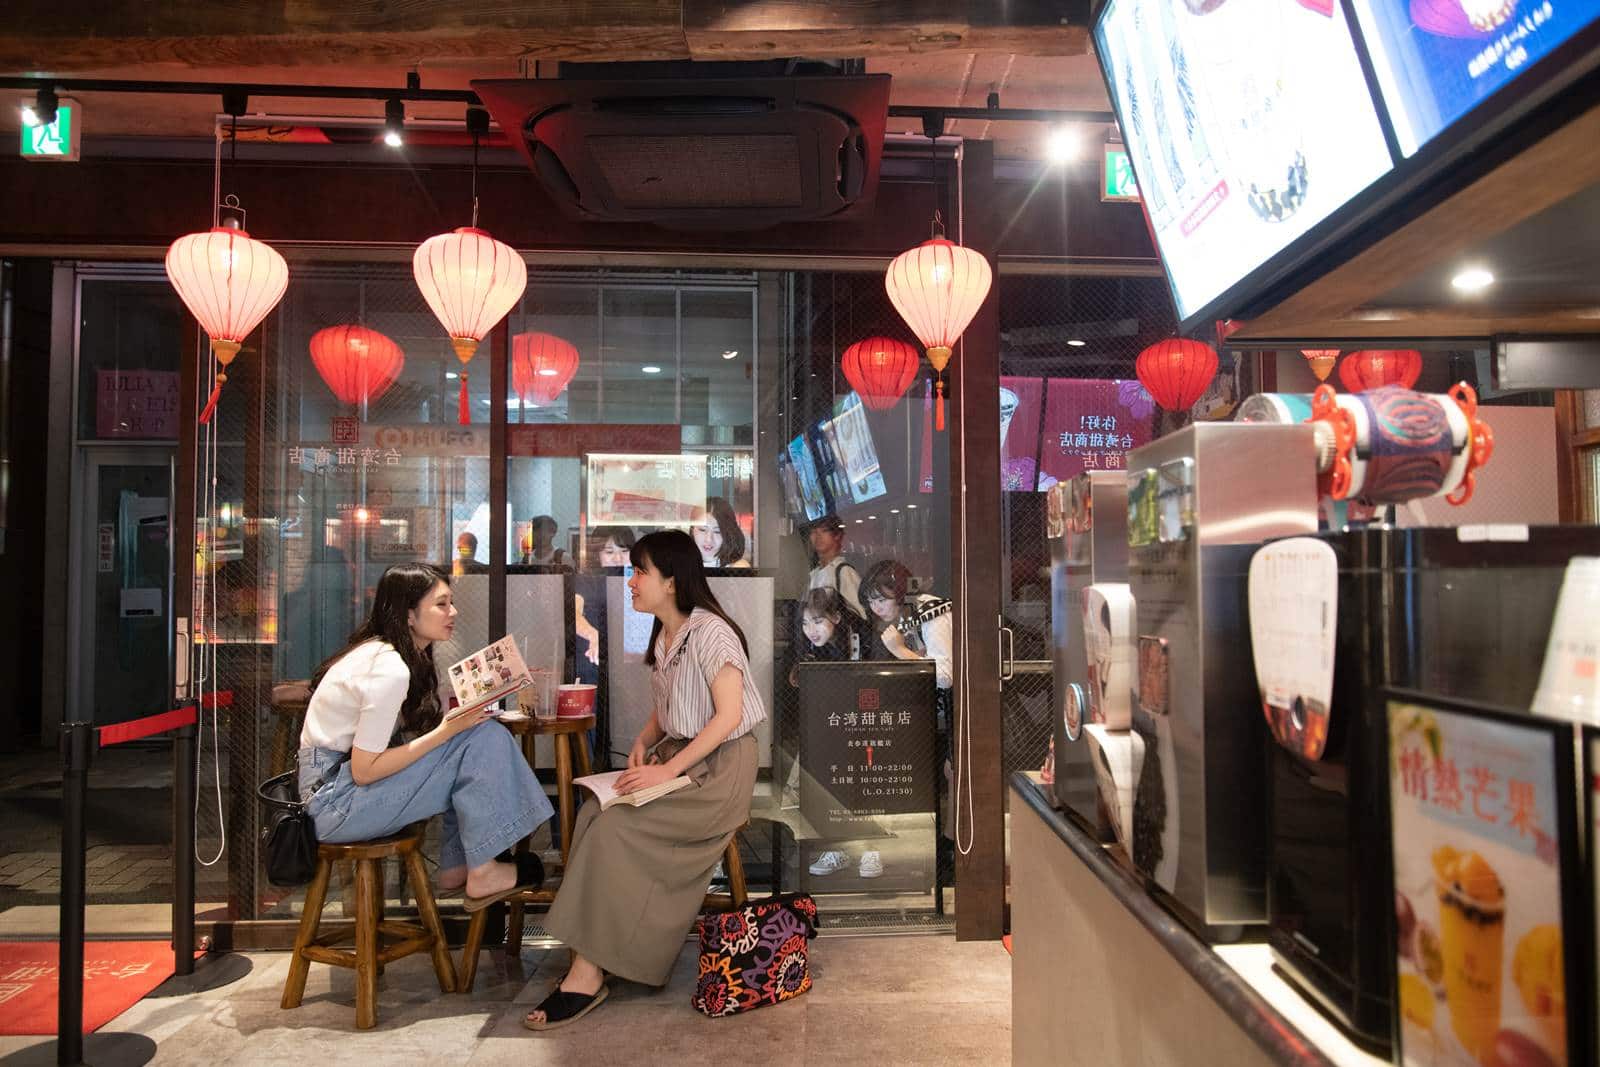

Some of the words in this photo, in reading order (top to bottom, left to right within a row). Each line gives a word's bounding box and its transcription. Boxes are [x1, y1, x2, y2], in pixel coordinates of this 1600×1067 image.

[828, 710, 912, 727] 台湾甜商店
